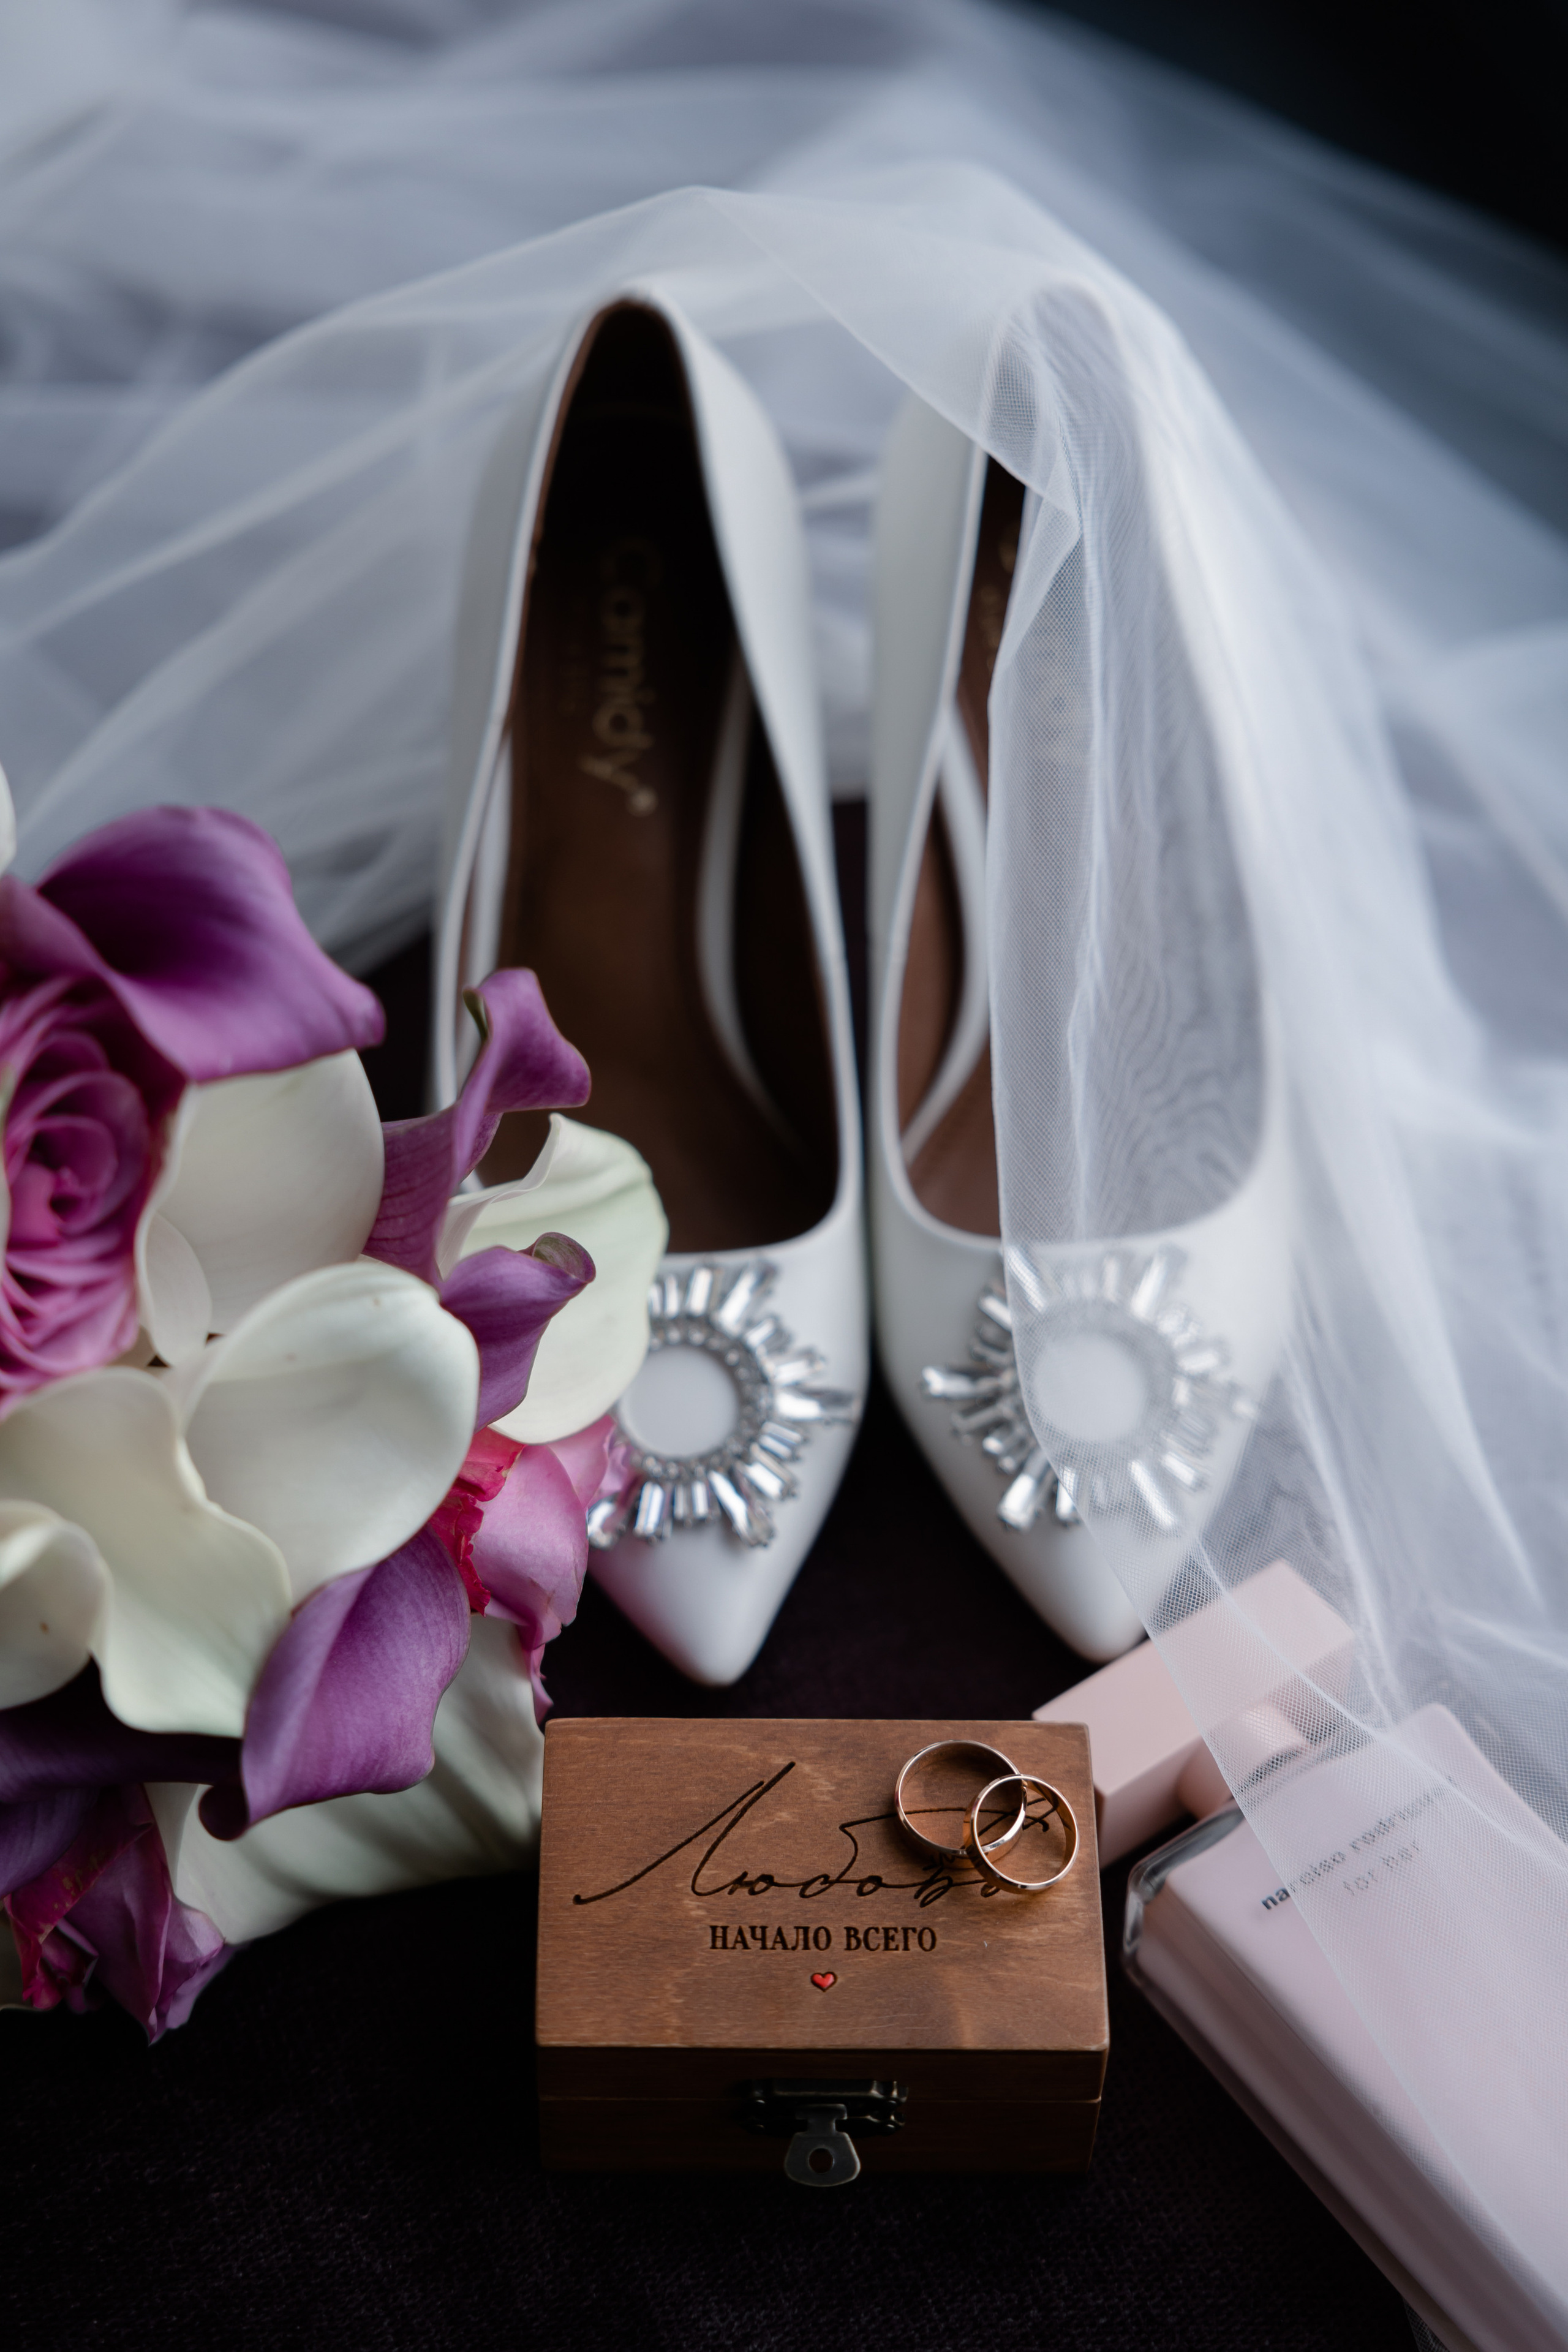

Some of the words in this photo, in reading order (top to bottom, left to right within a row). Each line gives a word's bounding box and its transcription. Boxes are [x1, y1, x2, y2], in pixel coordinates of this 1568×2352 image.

[1261, 1850, 1347, 1910] narciso
[709, 1924, 832, 1951] НАЧАЛО
[843, 1926, 937, 1952] ВСЕГО
